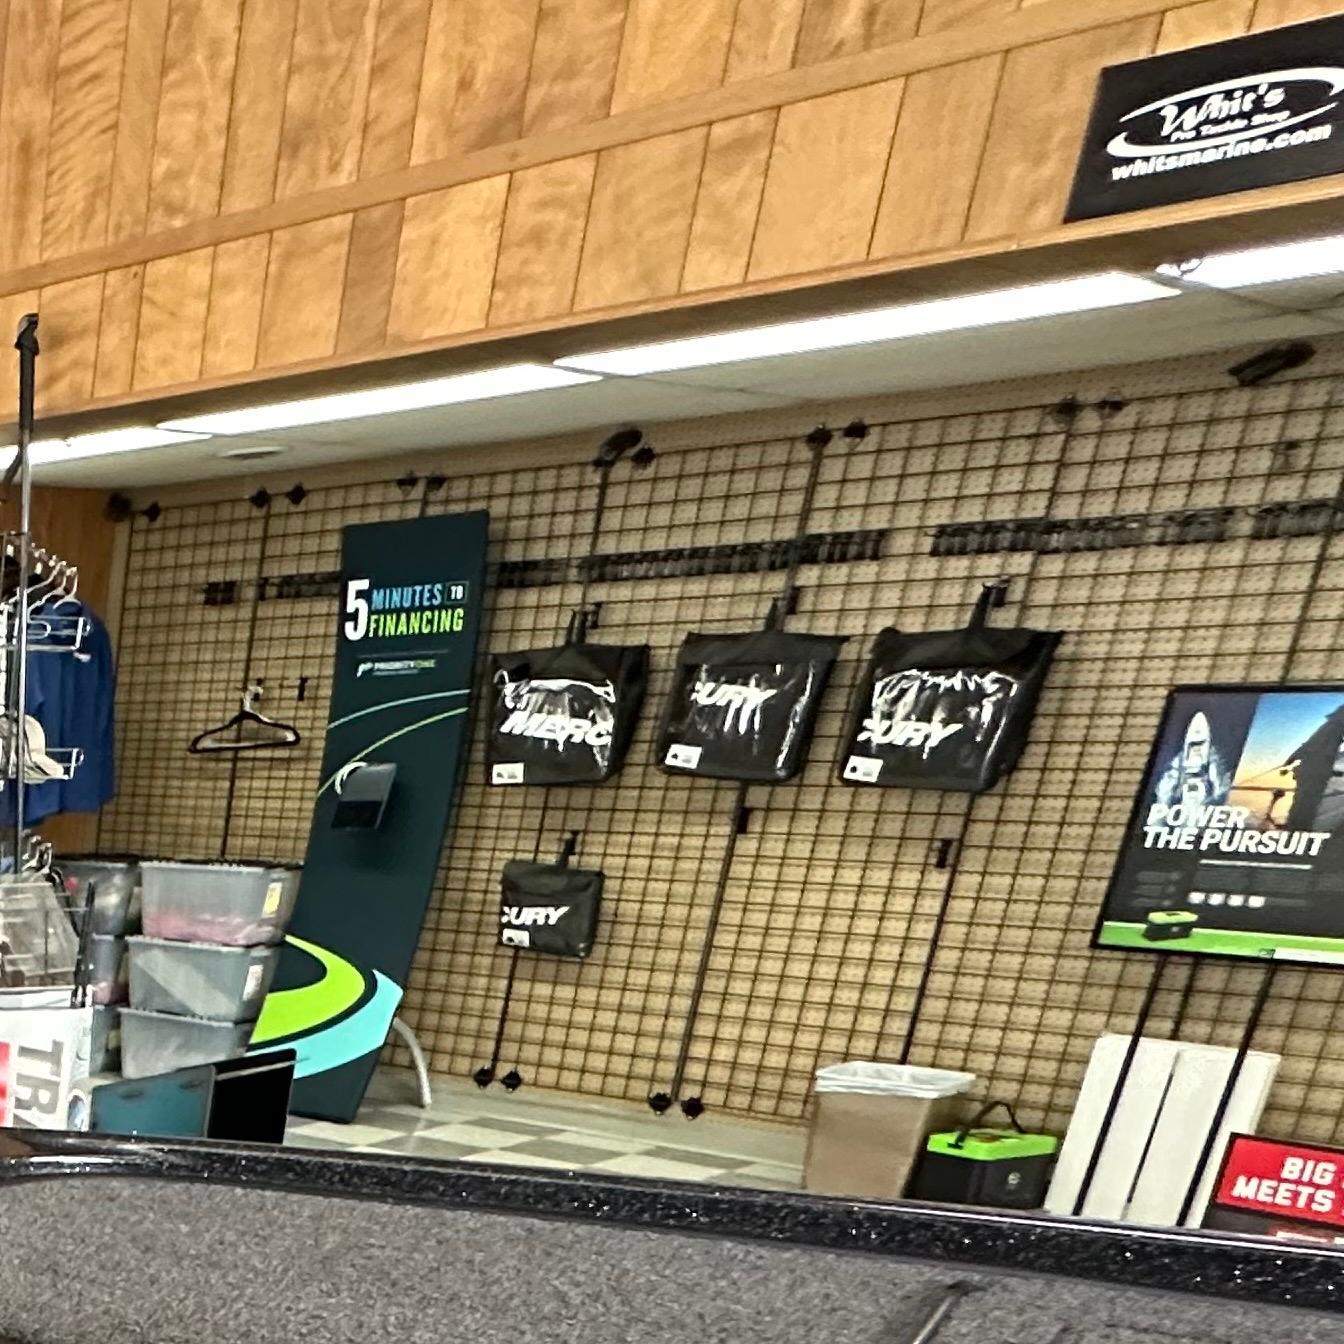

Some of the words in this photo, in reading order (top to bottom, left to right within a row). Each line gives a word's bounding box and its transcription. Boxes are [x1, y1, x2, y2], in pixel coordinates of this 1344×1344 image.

[1112, 124, 1332, 181] whitsmarine.com
[344, 579, 370, 642] 5
[371, 583, 443, 611] MINUTES
[368, 607, 465, 638] FINANCING
[1147, 803, 1249, 828] POWER
[1144, 826, 1198, 850] THE
[1200, 829, 1332, 856] PURSUIT
[1280, 1157, 1337, 1185] BIG
[1231, 1175, 1336, 1213] MEETS
